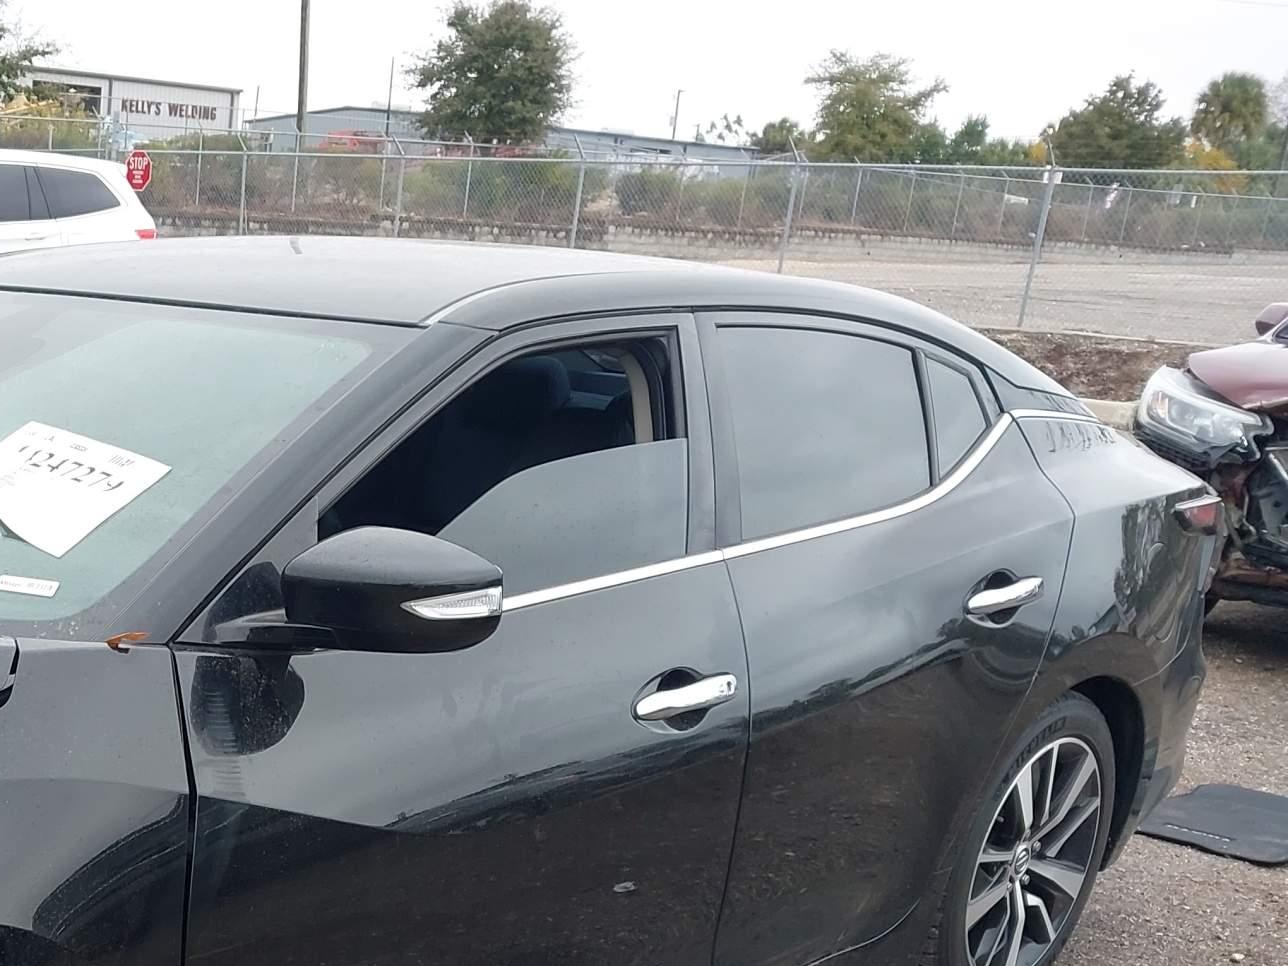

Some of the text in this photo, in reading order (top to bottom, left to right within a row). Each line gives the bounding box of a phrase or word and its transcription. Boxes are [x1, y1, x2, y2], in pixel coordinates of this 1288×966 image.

[121, 98, 217, 120] KELLY'S WELDING
[129, 157, 148, 170] STOP
